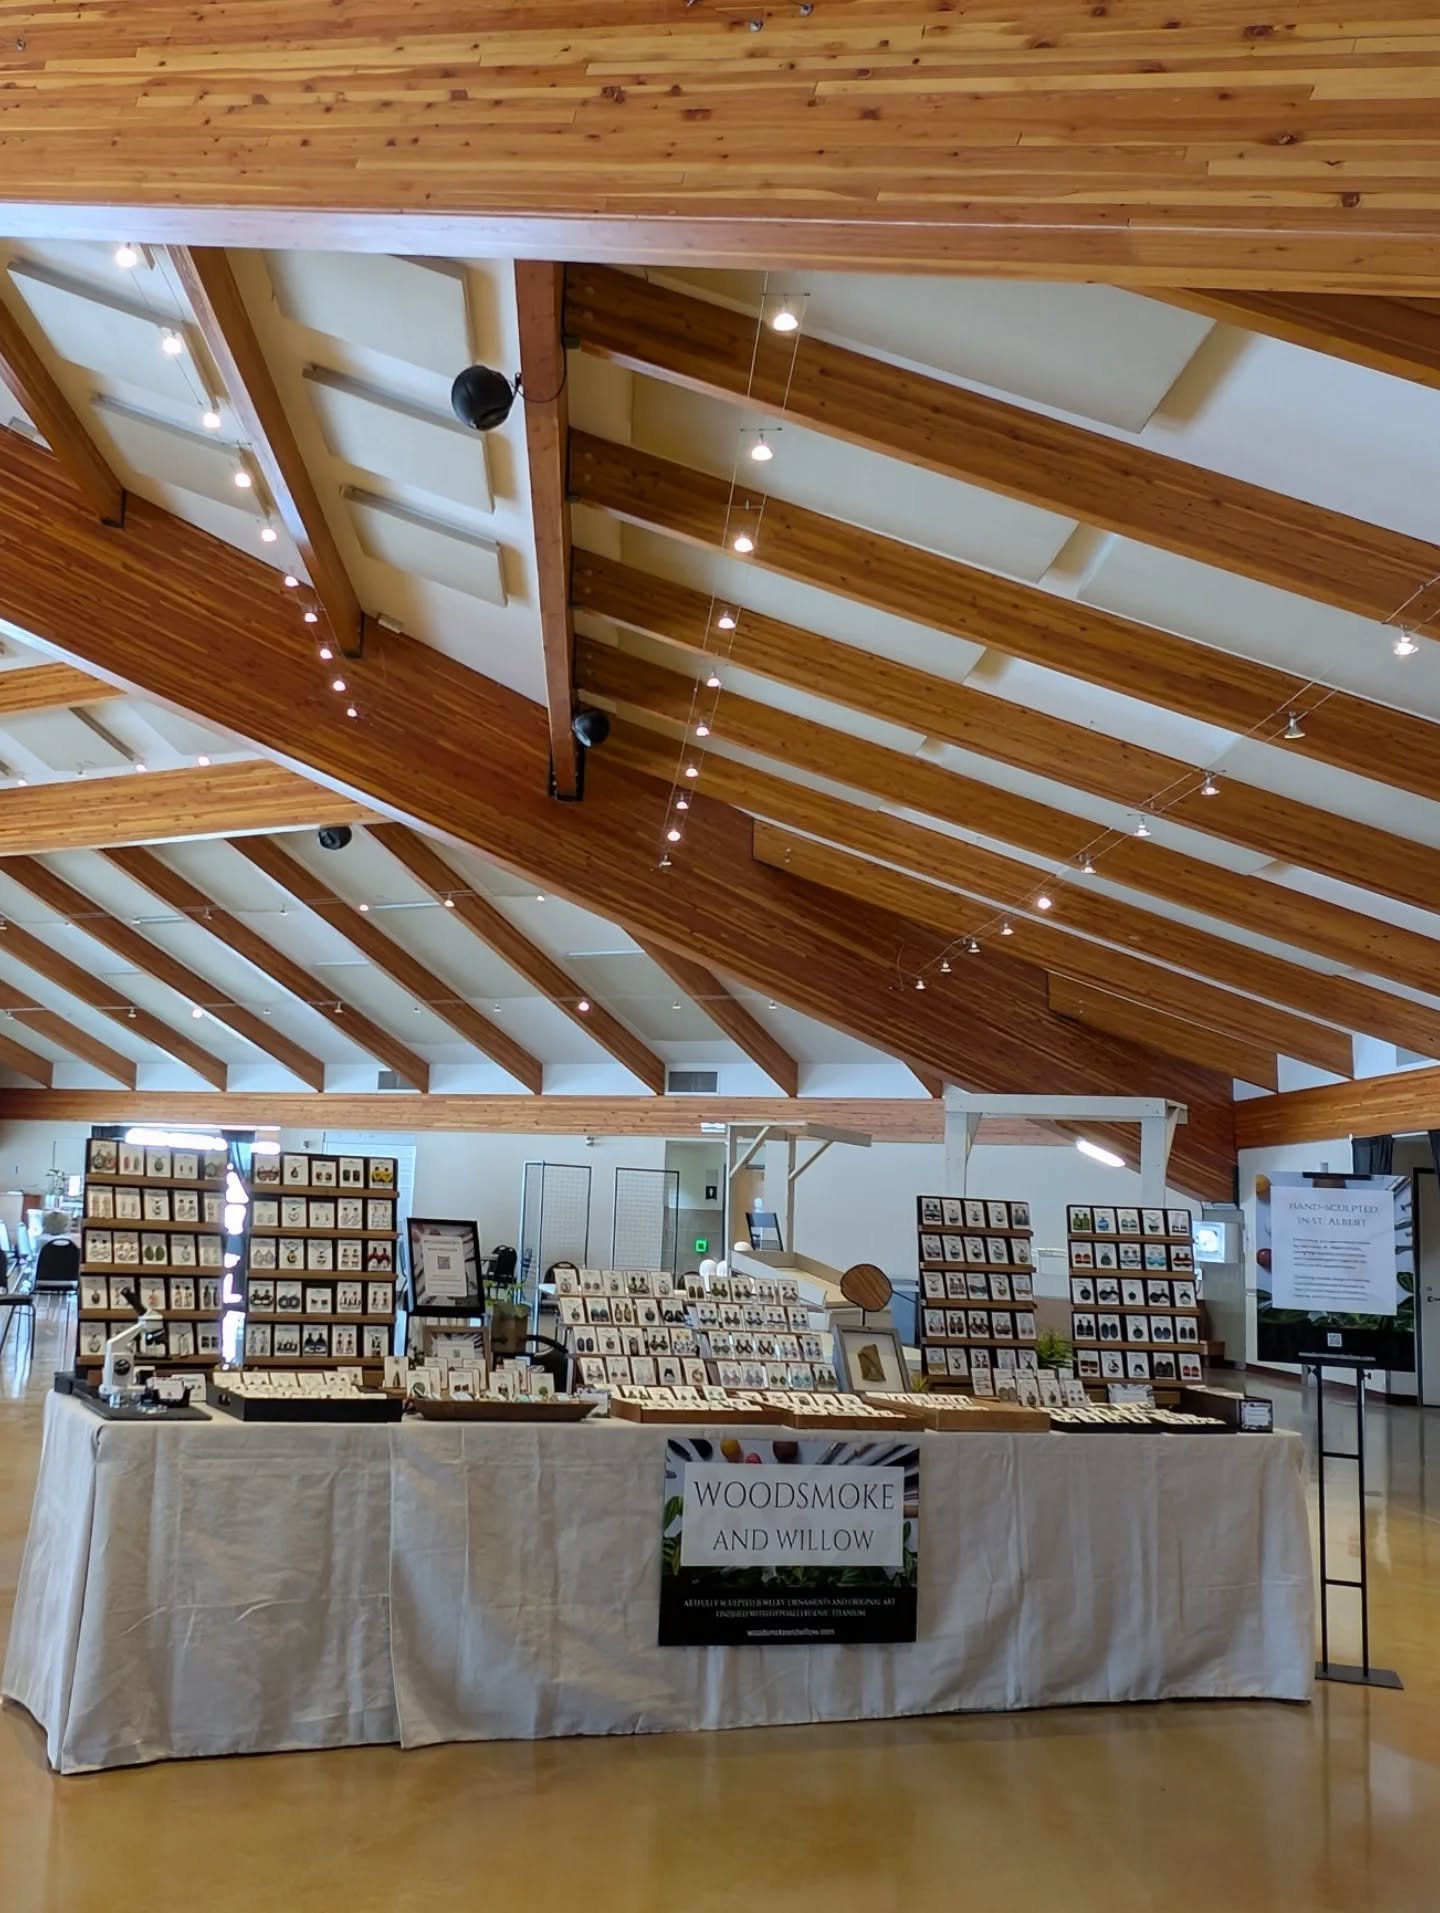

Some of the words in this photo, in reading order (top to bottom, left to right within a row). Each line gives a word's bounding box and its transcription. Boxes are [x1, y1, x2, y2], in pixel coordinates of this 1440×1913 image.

[1288, 1202, 1379, 1214] HAND-SCULPTED
[1328, 1217, 1367, 1227] ALBERT
[693, 1480, 895, 1510] WOODSMOKE
[712, 1528, 769, 1551] AND
[776, 1528, 874, 1552] WILLOW
